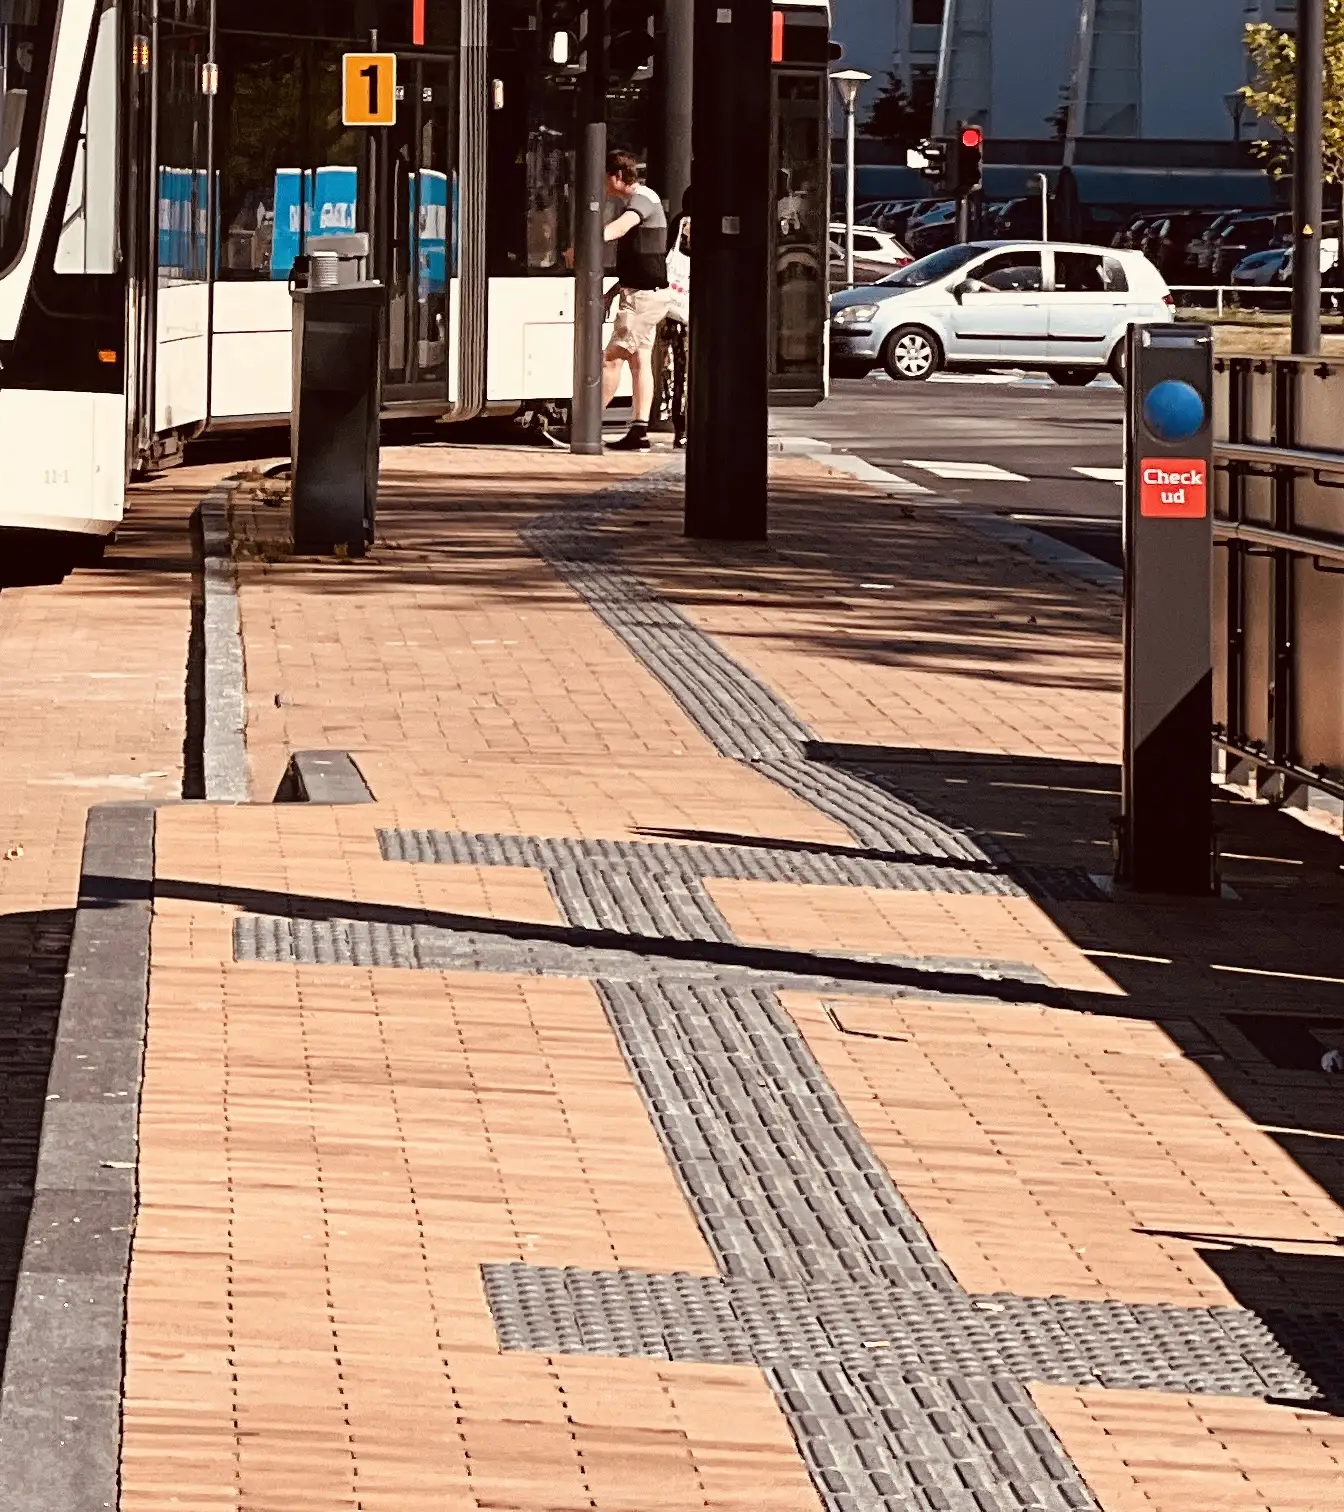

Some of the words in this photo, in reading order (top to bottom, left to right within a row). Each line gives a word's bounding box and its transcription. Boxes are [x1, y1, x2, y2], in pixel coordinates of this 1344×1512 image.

[359, 64, 379, 116] 1
[1143, 468, 1203, 485] Check
[1161, 488, 1185, 504] ud
